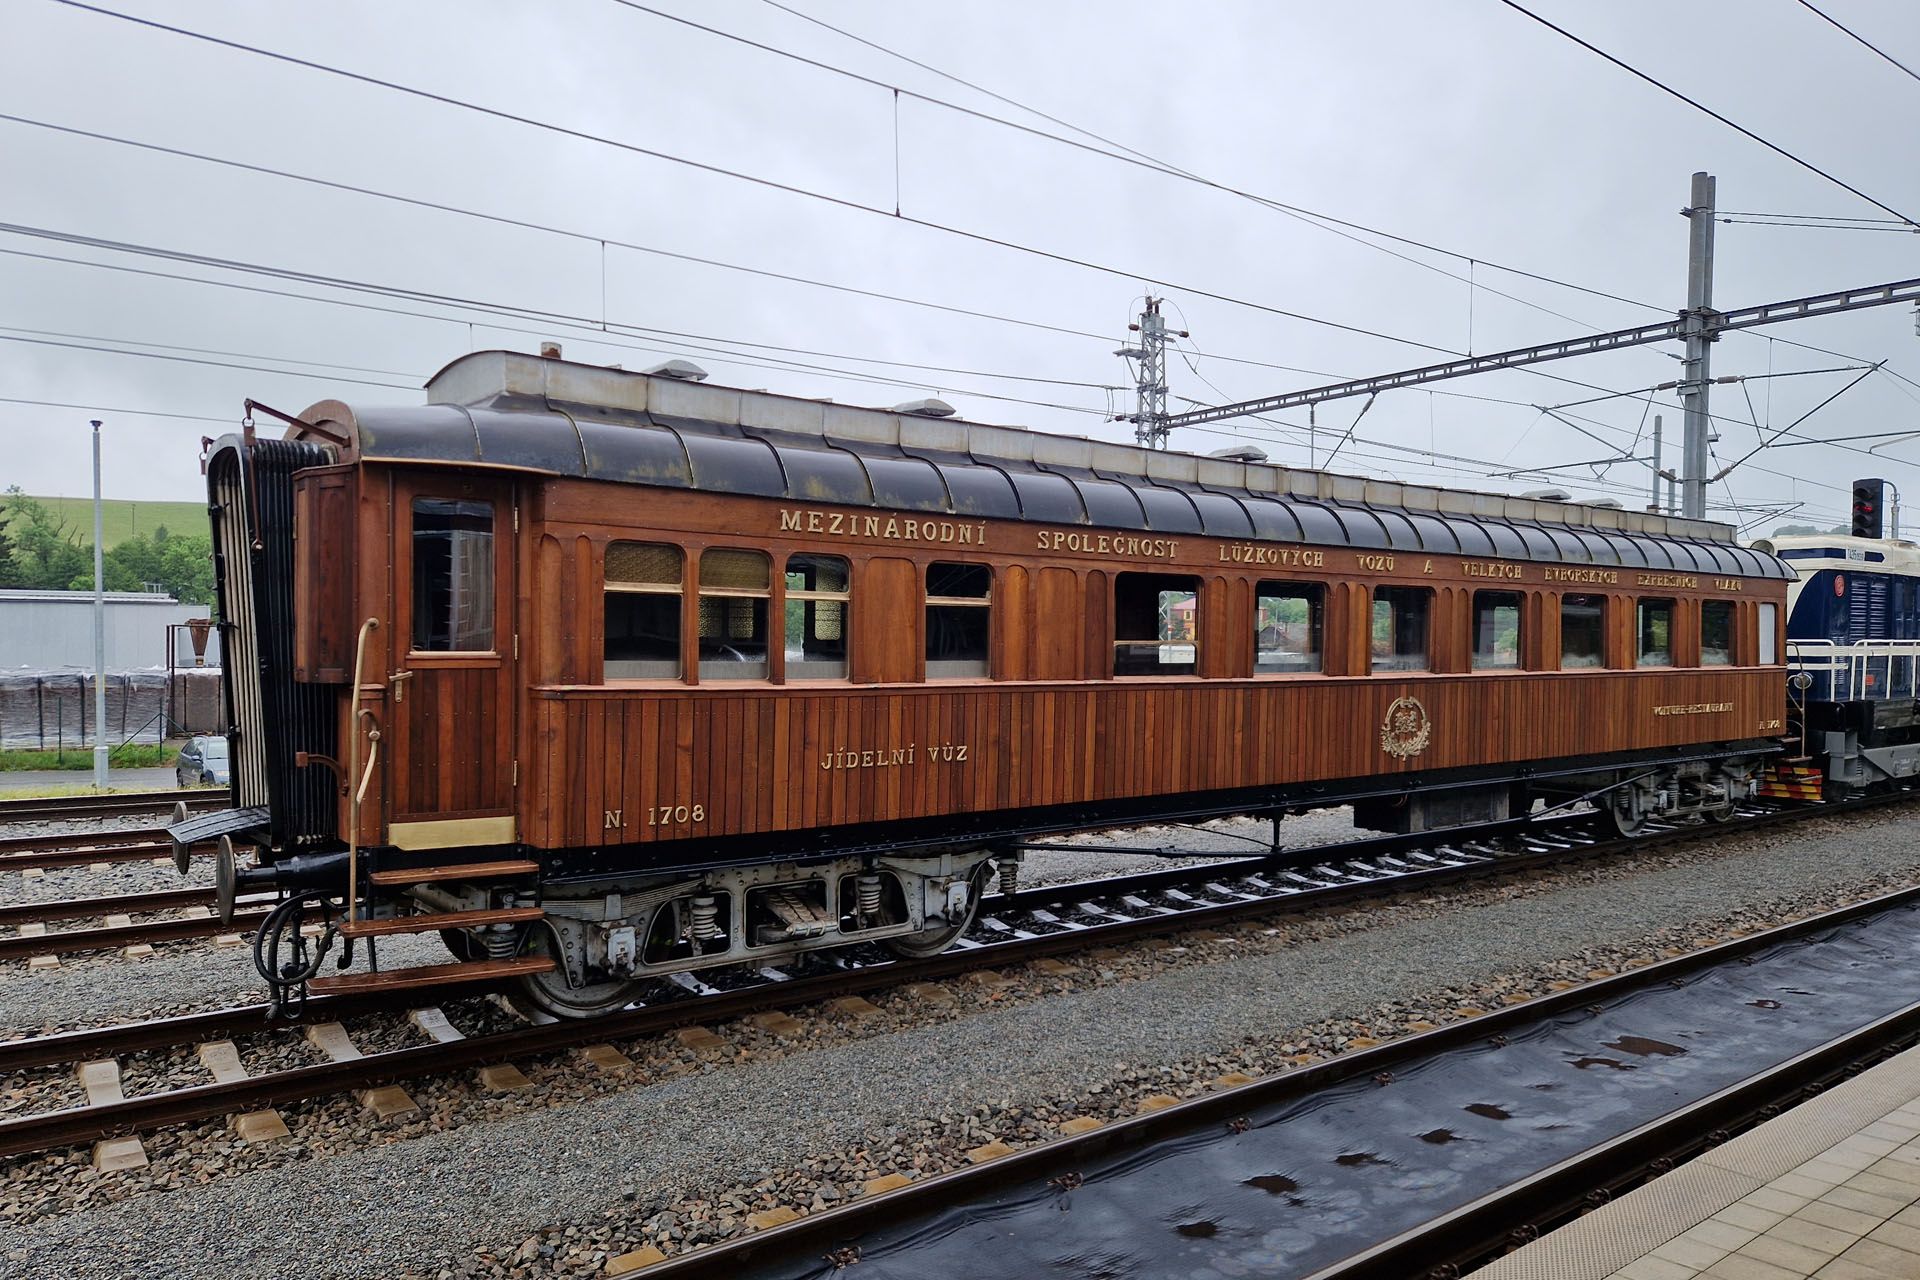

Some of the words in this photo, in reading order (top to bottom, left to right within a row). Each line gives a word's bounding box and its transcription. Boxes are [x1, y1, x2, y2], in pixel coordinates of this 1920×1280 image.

[780, 509, 986, 545] MEZINÁRODNÍ
[1037, 531, 1179, 558] SPOLEČNOST
[1219, 542, 1324, 567] LŮŽKOVÝCH
[1356, 553, 1394, 571] VOZŮ
[1423, 560, 1433, 574] A
[1461, 560, 1522, 579] VELKÝCH
[821, 744, 915, 770] JÍDELNÍ
[927, 742, 968, 762] VŮZ
[605, 809, 628, 829] N.
[648, 804, 705, 826] 1708
